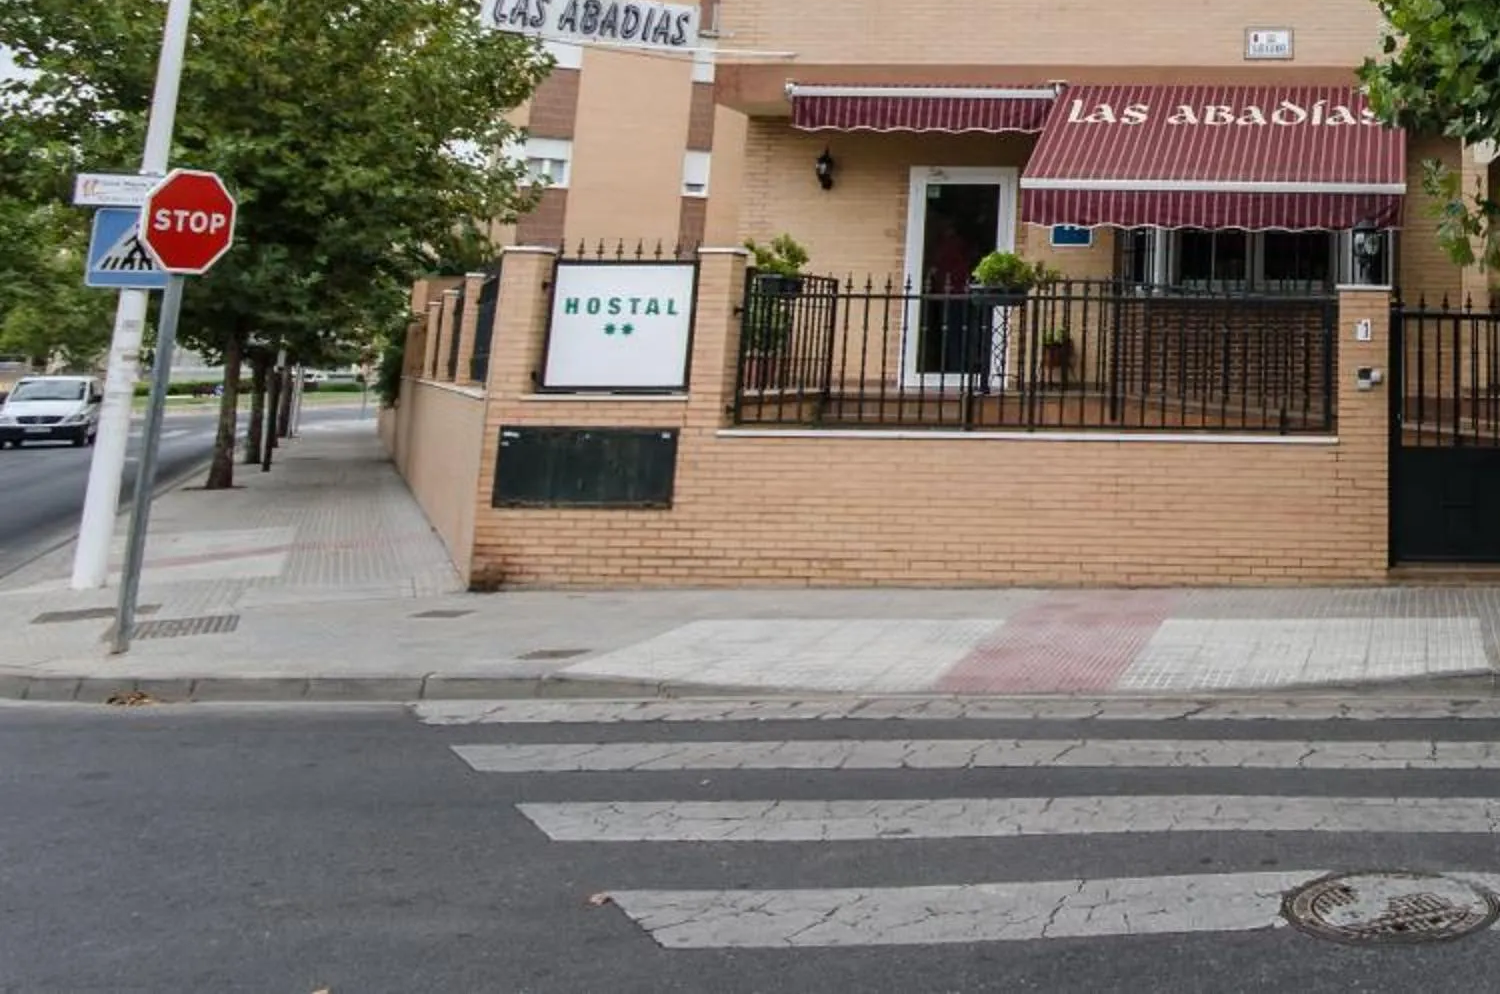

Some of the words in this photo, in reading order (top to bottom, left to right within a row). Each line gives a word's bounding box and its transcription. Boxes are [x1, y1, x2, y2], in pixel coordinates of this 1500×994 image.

[1067, 99, 1149, 125] LAS
[153, 208, 226, 235] STOP
[565, 297, 678, 315] HOSTAL
